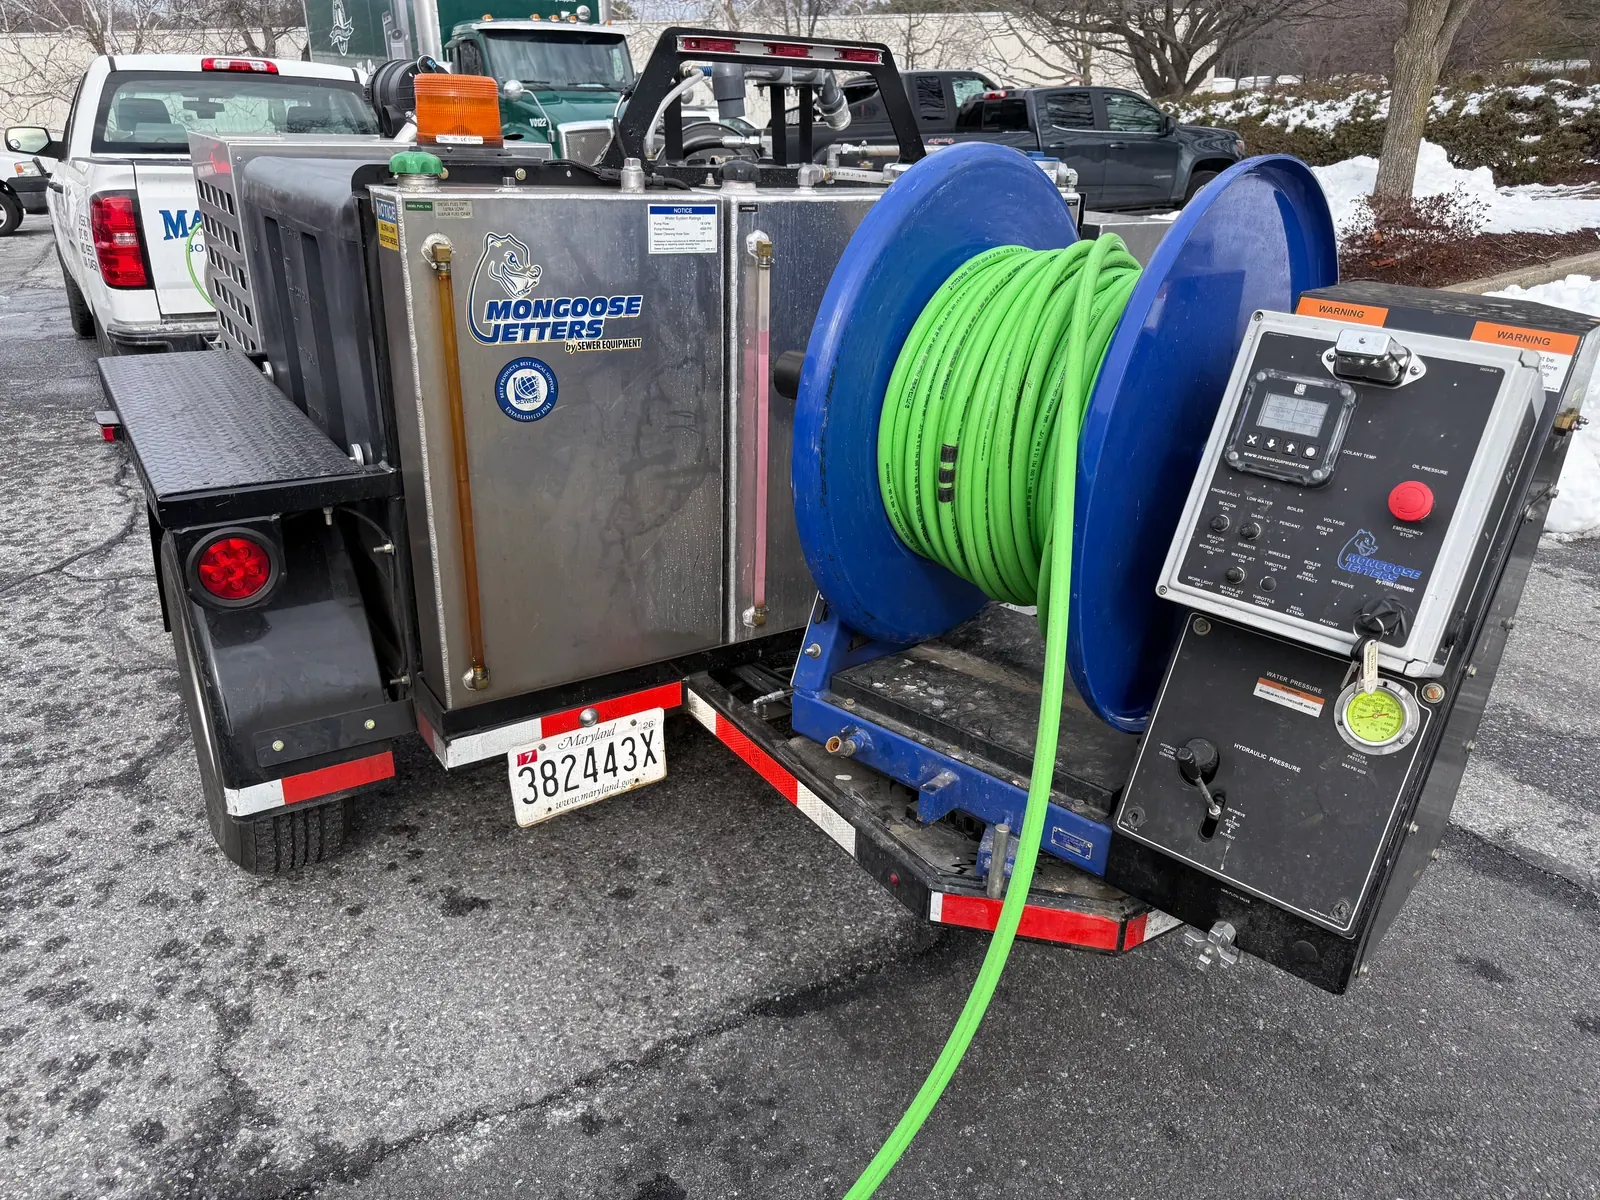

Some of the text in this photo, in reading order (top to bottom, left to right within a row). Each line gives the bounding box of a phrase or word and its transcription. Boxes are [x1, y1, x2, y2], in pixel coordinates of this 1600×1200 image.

[485, 296, 643, 320] MONGOOSE
[1319, 305, 1365, 319] WARNING
[488, 320, 604, 343] JETTERS
[1497, 330, 1552, 346] WARNING
[565, 339, 642, 353] by SEWER EQUIPMENT
[532, 363, 546, 373] LOCAL
[545, 372, 554, 394] SUPPORT
[506, 403, 552, 420] ESTABLISHED 1941
[1421, 466, 1448, 475] PRESSURE
[1257, 498, 1274, 506] WATER
[1279, 521, 1300, 529] PENDANT
[1324, 517, 1345, 526] VOLTAGE
[1316, 525, 1334, 533] BOILER
[1393, 525, 1424, 536] EMERGENCY
[1207, 534, 1225, 542] BEACON
[1238, 542, 1256, 550] REMOTE
[1231, 552, 1246, 560] WATER
[1268, 550, 1291, 560] WIRELESS
[1264, 561, 1287, 571] THROTTLE
[1304, 560, 1321, 568] BOILER
[1345, 553, 1422, 579] MONGOOSE
[1342, 562, 1399, 583] JETTERS
[1296, 575, 1318, 584] RETRACT
[1331, 580, 1355, 589] RETRIEVE
[1394, 582, 1415, 593] EQUIPMENT
[1221, 590, 1239, 598] BYPASS
[1253, 594, 1275, 604] THROTTLE
[1286, 609, 1305, 617] EXTEND
[1320, 618, 1339, 627] PAYOUT
[1266, 671, 1322, 694] WATER PRESSURE
[643, 720, 654, 730] 26
[558, 723, 617, 750] Maryland
[525, 752, 532, 763] 7
[1234, 743, 1301, 773] HYDRAULIC PRESSURE
[1347, 754, 1368, 765] PRESSURE
[518, 730, 658, 805] 382443X
[556, 780, 634, 809] www.maryland.gov
[1227, 807, 1246, 818] RETRIEVE
[1220, 831, 1236, 840] PAYOUT
